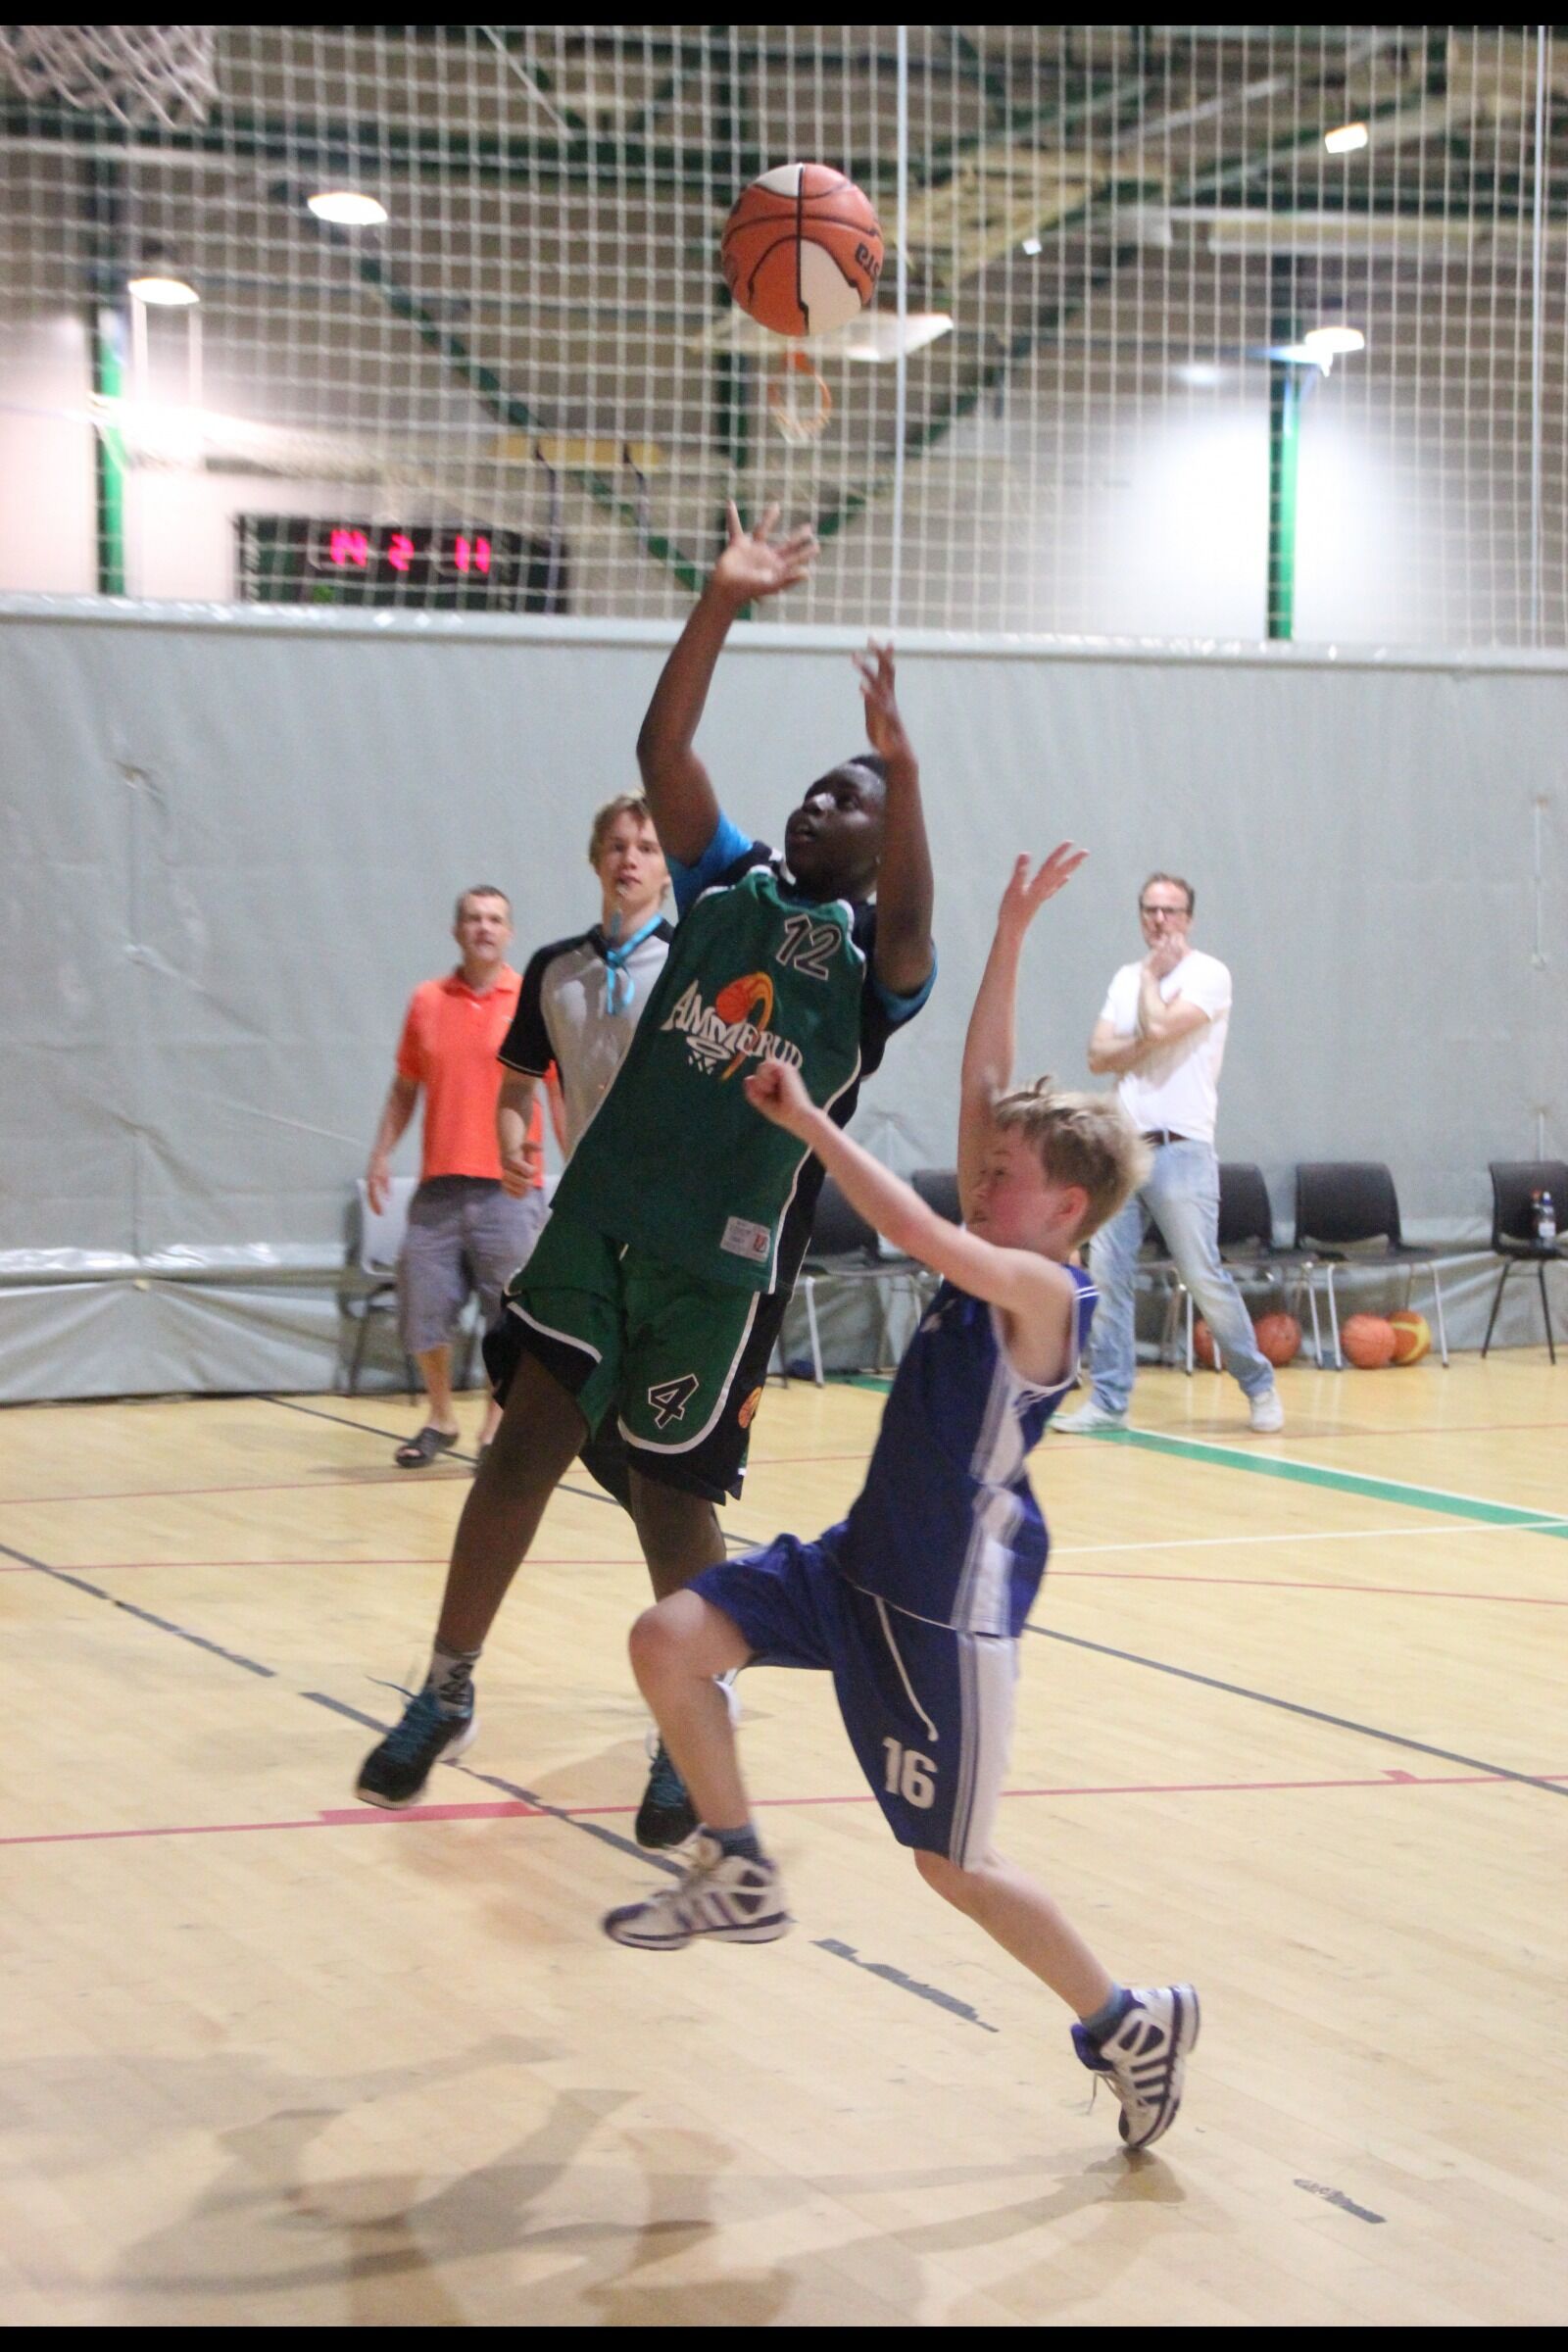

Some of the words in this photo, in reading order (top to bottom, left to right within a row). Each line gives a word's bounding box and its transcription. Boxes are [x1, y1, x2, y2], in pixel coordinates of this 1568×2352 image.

[776, 913, 842, 981] 12
[660, 978, 804, 1069] AMMERUD
[648, 1373, 700, 1429] 4
[882, 1737, 939, 1809] 16
